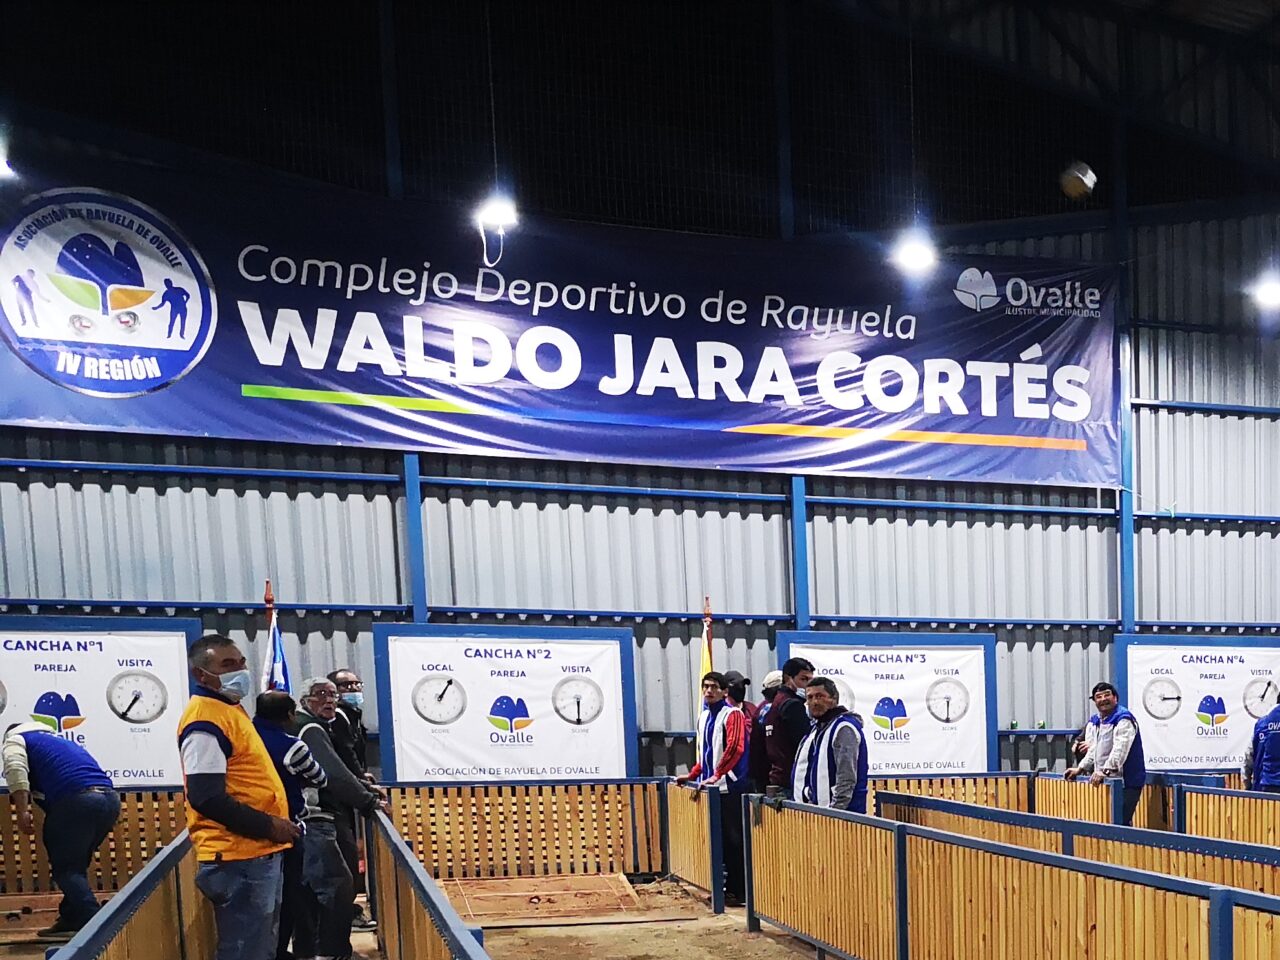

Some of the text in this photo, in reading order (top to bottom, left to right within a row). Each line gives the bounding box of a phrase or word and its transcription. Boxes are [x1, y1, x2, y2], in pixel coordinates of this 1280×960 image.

[136, 222, 151, 239] DE
[149, 235, 182, 268] OVALLE
[237, 243, 917, 340] Complejo Deportivo de Rayuela
[1005, 277, 1101, 309] Ovalle
[56, 350, 161, 381] IV REGIÓN
[237, 300, 1092, 422] WALDO JARA CORTÉS
[3, 639, 73, 652] CANCHA
[463, 647, 524, 659] CANCHA
[117, 658, 153, 667] VISITA
[852, 653, 903, 664] CANCHA
[1181, 654, 1225, 664] CANCHA
[34, 663, 77, 672] PAREJA
[421, 663, 454, 672] LOCAL
[561, 665, 592, 674] VISITA
[817, 668, 845, 676] LOCAL
[934, 668, 960, 676] VISITA
[1150, 668, 1174, 676] LOCAL
[1250, 668, 1273, 677] VISITA
[490, 669, 527, 678] PAREJA
[874, 673, 905, 681] PAREJA
[1199, 672, 1226, 681] PAREJA
[873, 730, 911, 742] Ovalle
[1196, 726, 1229, 737] Ovalle
[489, 732, 534, 744] Ovalle
[1148, 754, 1193, 764] ASOCIACIÓN
[872, 760, 966, 770] DE RAYUELA DE OVALLE
[122, 769, 164, 778] OVALLE
[424, 765, 600, 777] ASOCIACIÓN DE RAYUELA DE OVALLE
